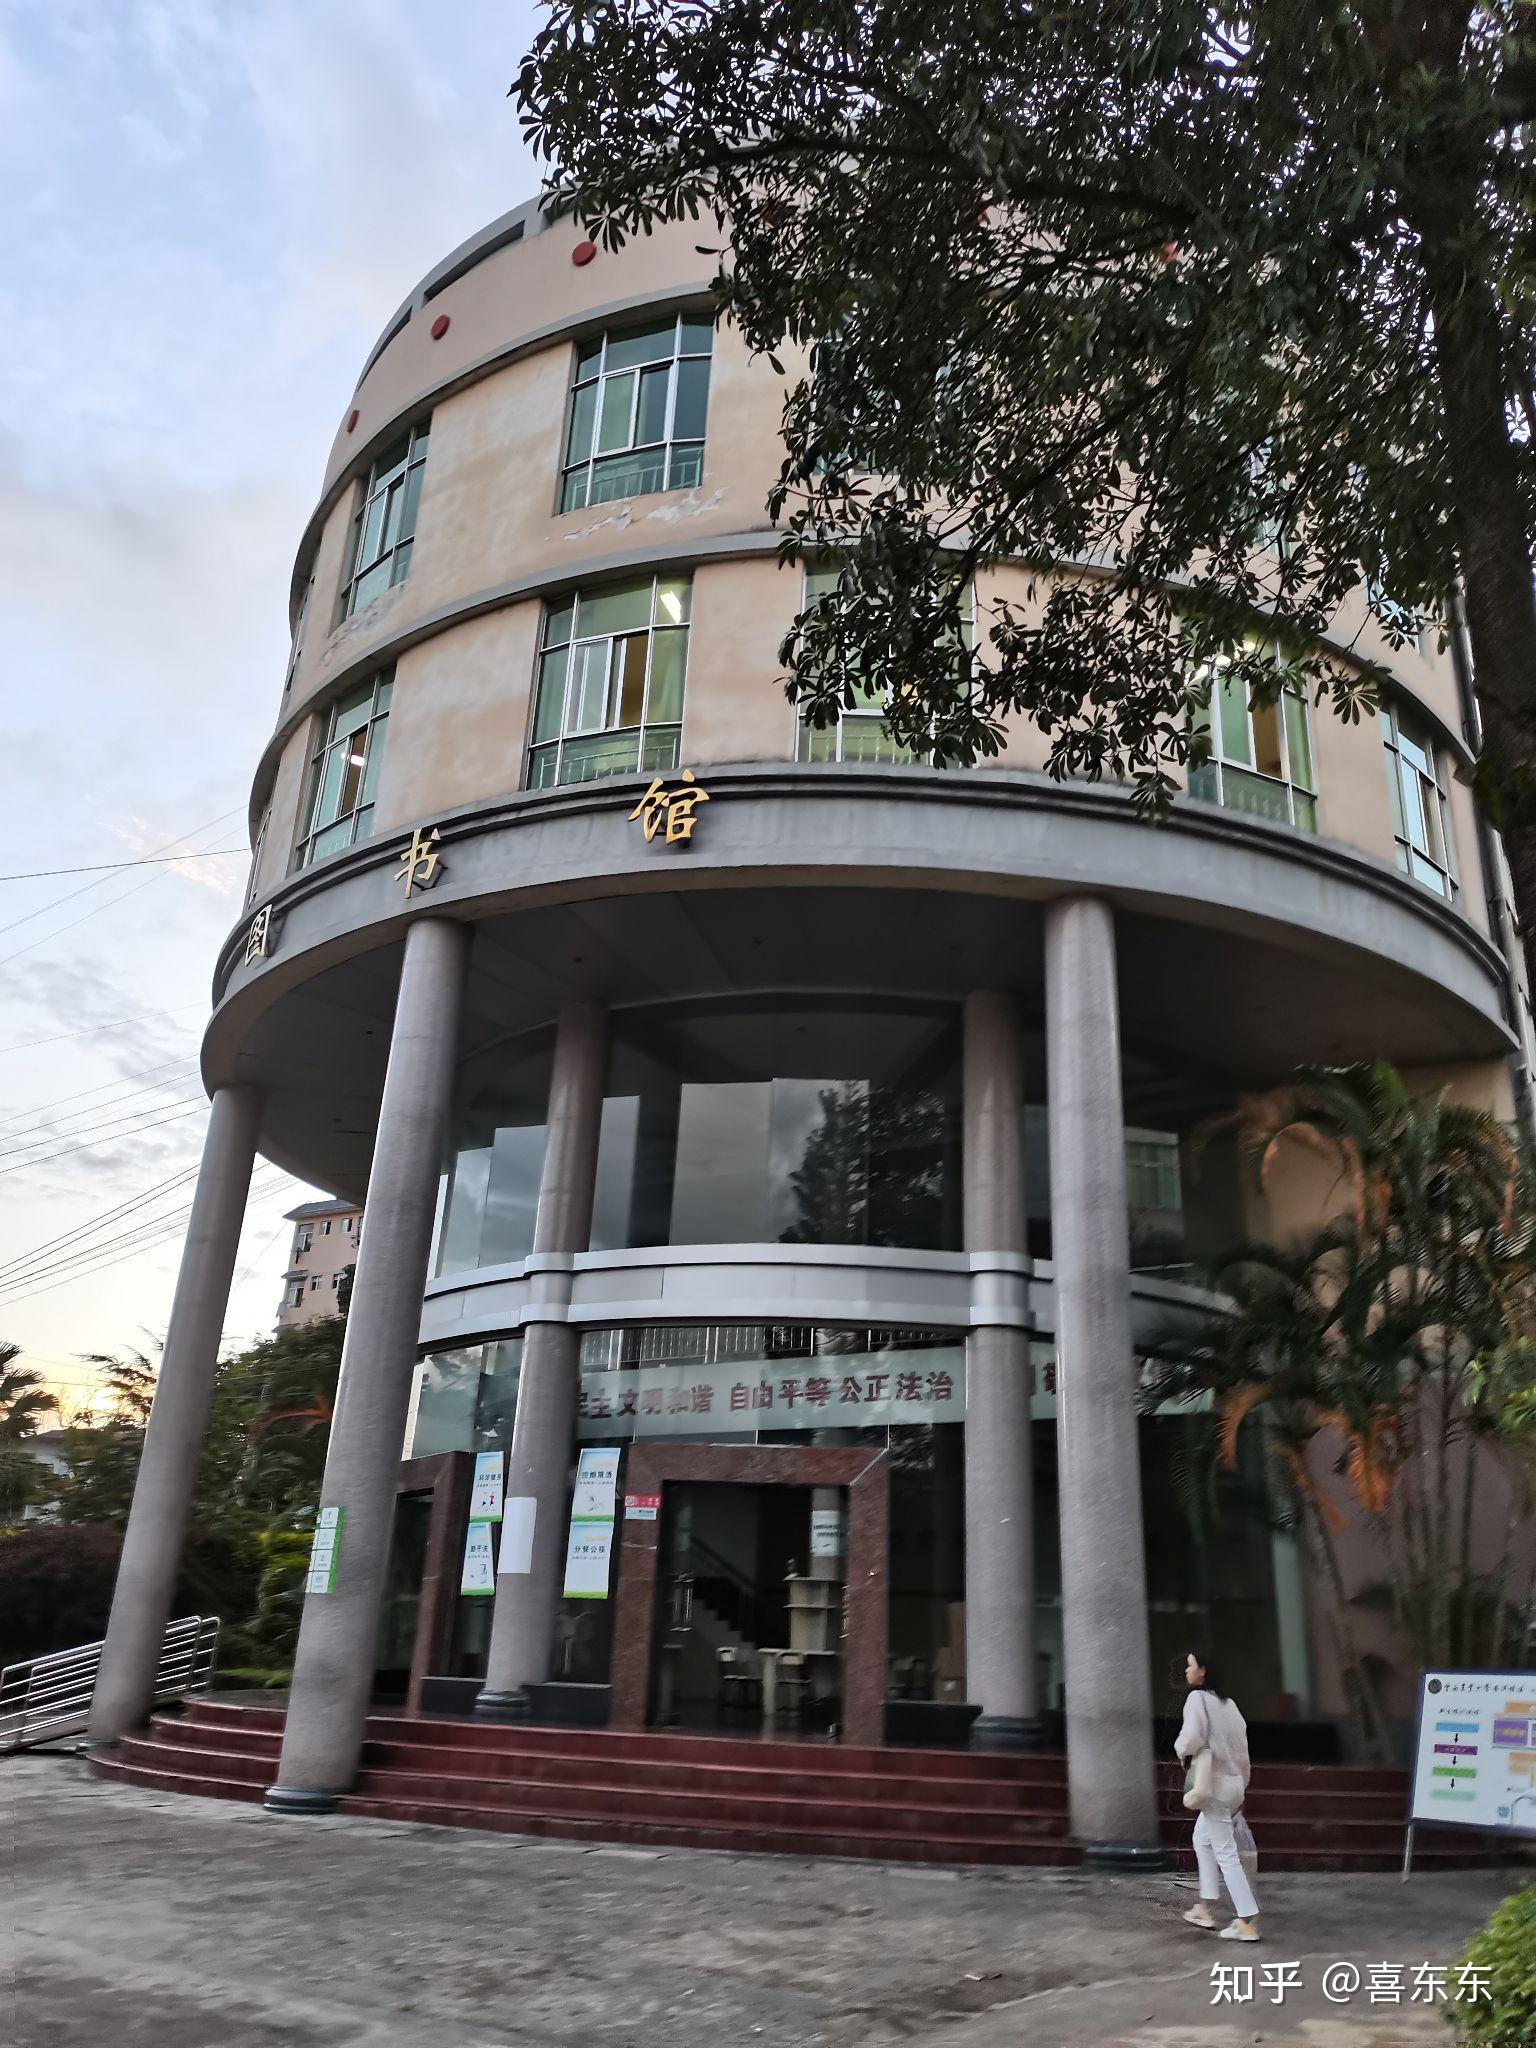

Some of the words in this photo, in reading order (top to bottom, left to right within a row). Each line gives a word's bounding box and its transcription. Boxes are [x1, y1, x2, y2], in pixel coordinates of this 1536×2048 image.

[244, 769, 710, 967] 图书馆
[729, 1370, 955, 1412] 自由平等公正法治
